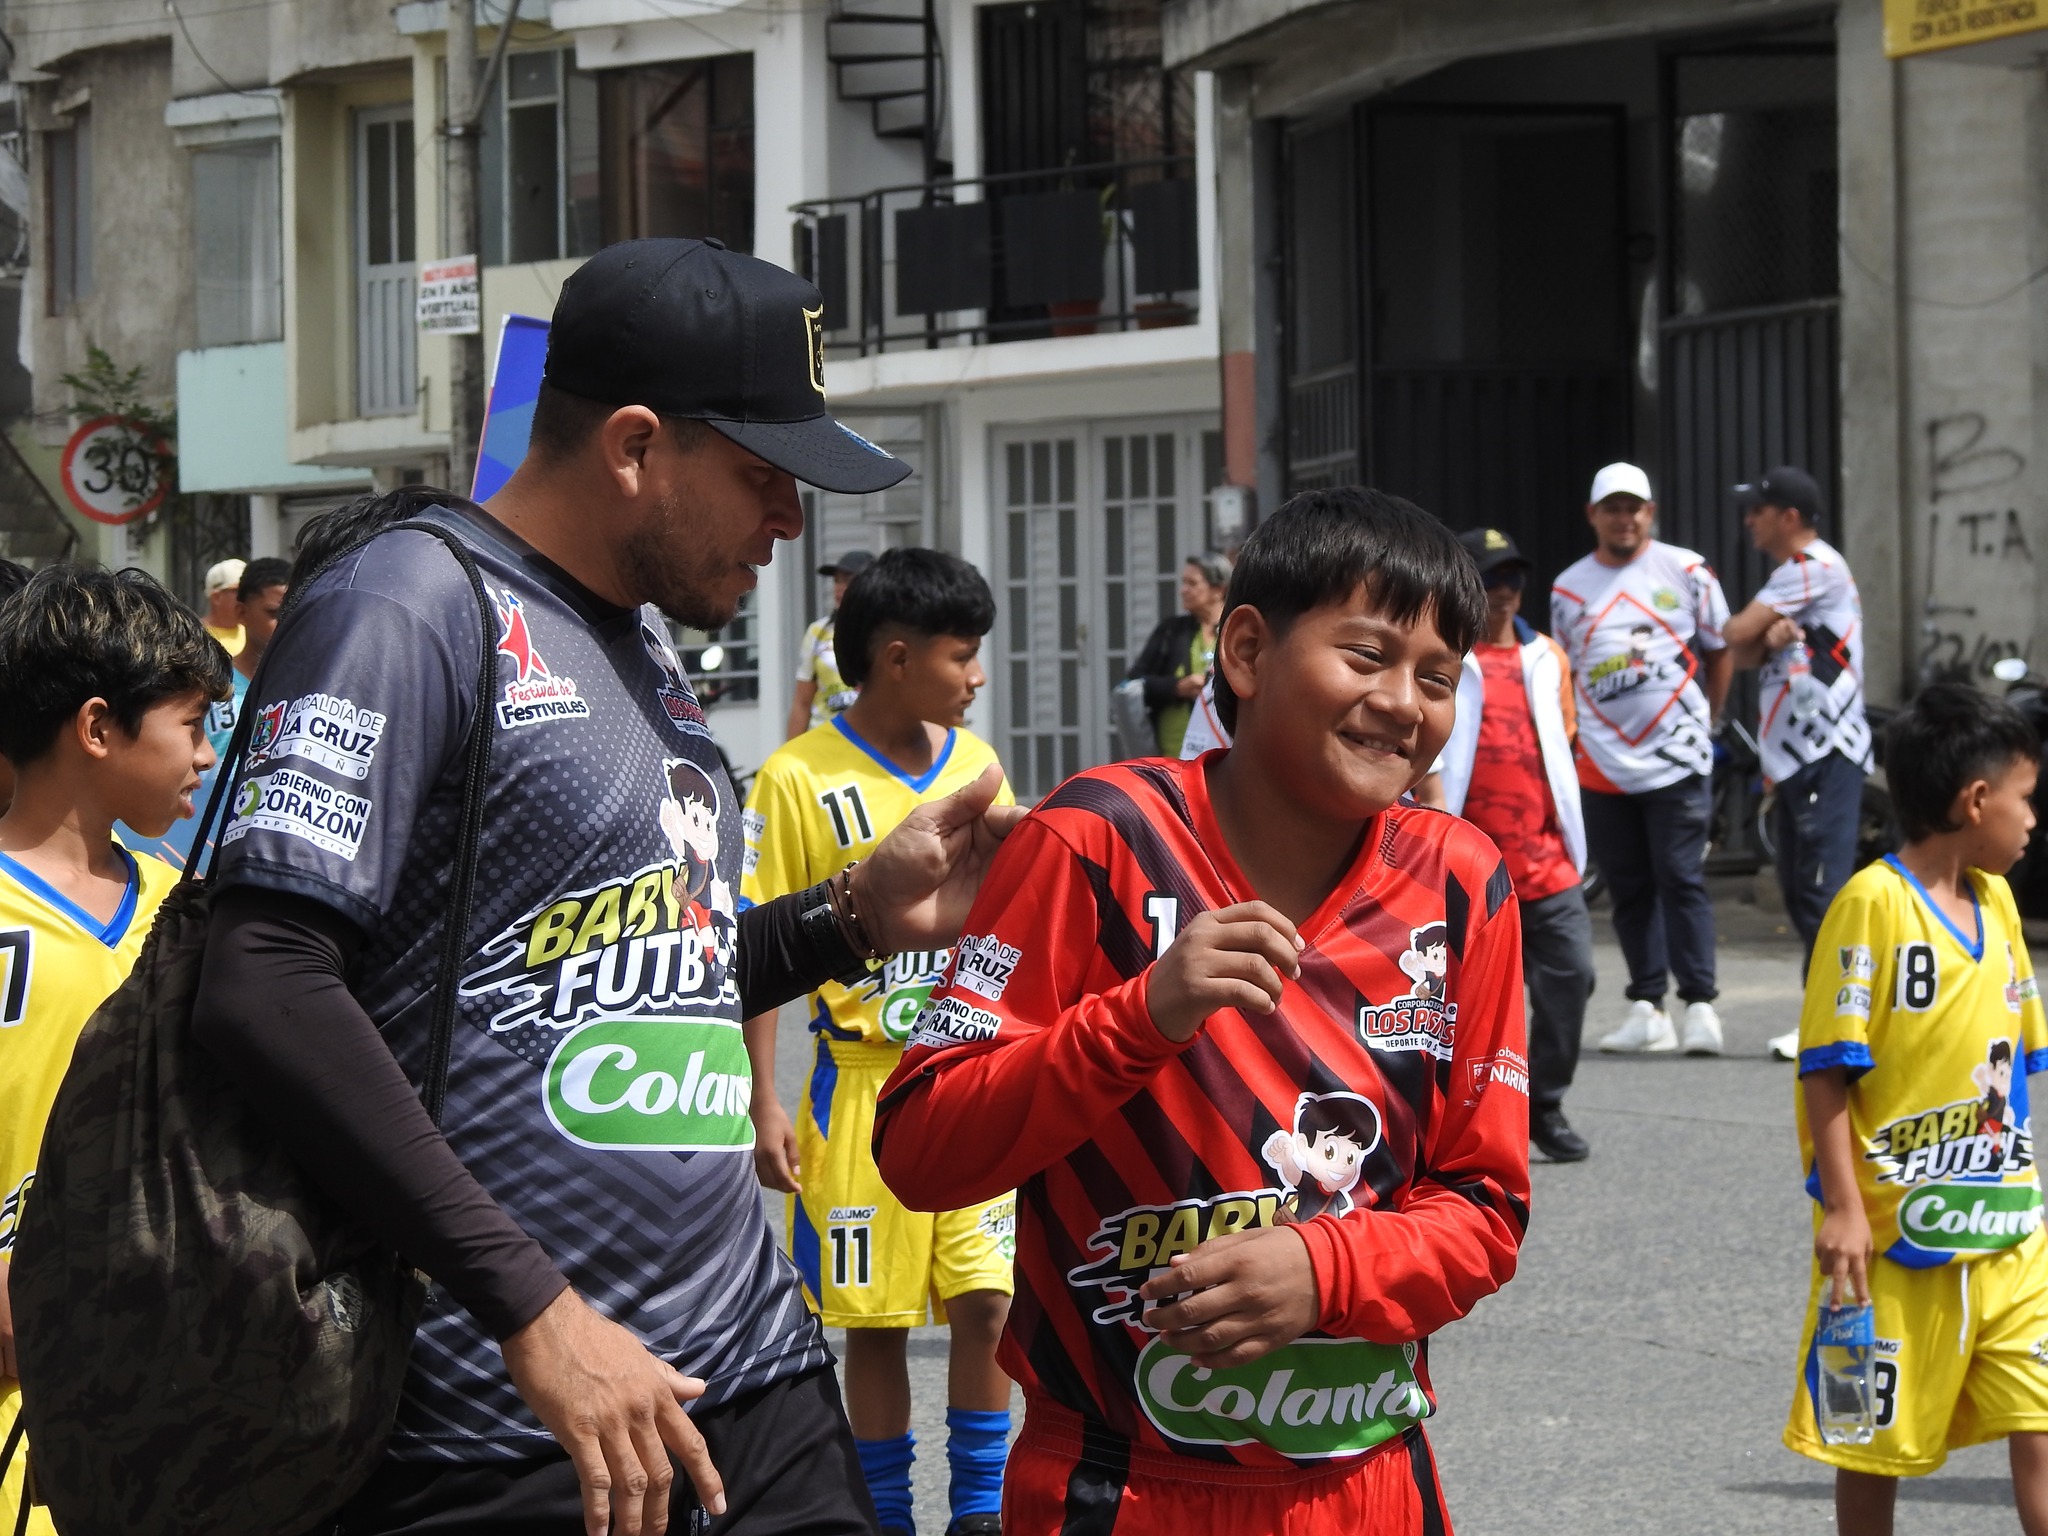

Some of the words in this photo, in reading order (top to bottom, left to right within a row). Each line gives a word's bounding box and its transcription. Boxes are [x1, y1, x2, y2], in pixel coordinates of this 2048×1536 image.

[84, 445, 150, 494] 30
[508, 681, 558, 704] Festival
[290, 696, 354, 724] ALCALDÍA
[358, 712, 384, 732] DE
[308, 717, 376, 758] CRUZ
[270, 771, 332, 804] OBIERNO
[334, 794, 368, 818] CON
[741, 817, 764, 835] RUZ
[821, 785, 872, 846] 11
[968, 952, 1012, 984] RUZ
[999, 945, 1020, 964] DE
[970, 1011, 999, 1028] CON
[1367, 1008, 1412, 1036] LOS
[1385, 1037, 1419, 1048] DEPORTE
[830, 1227, 868, 1284] 11
[1148, 1354, 1418, 1428] Colanta
